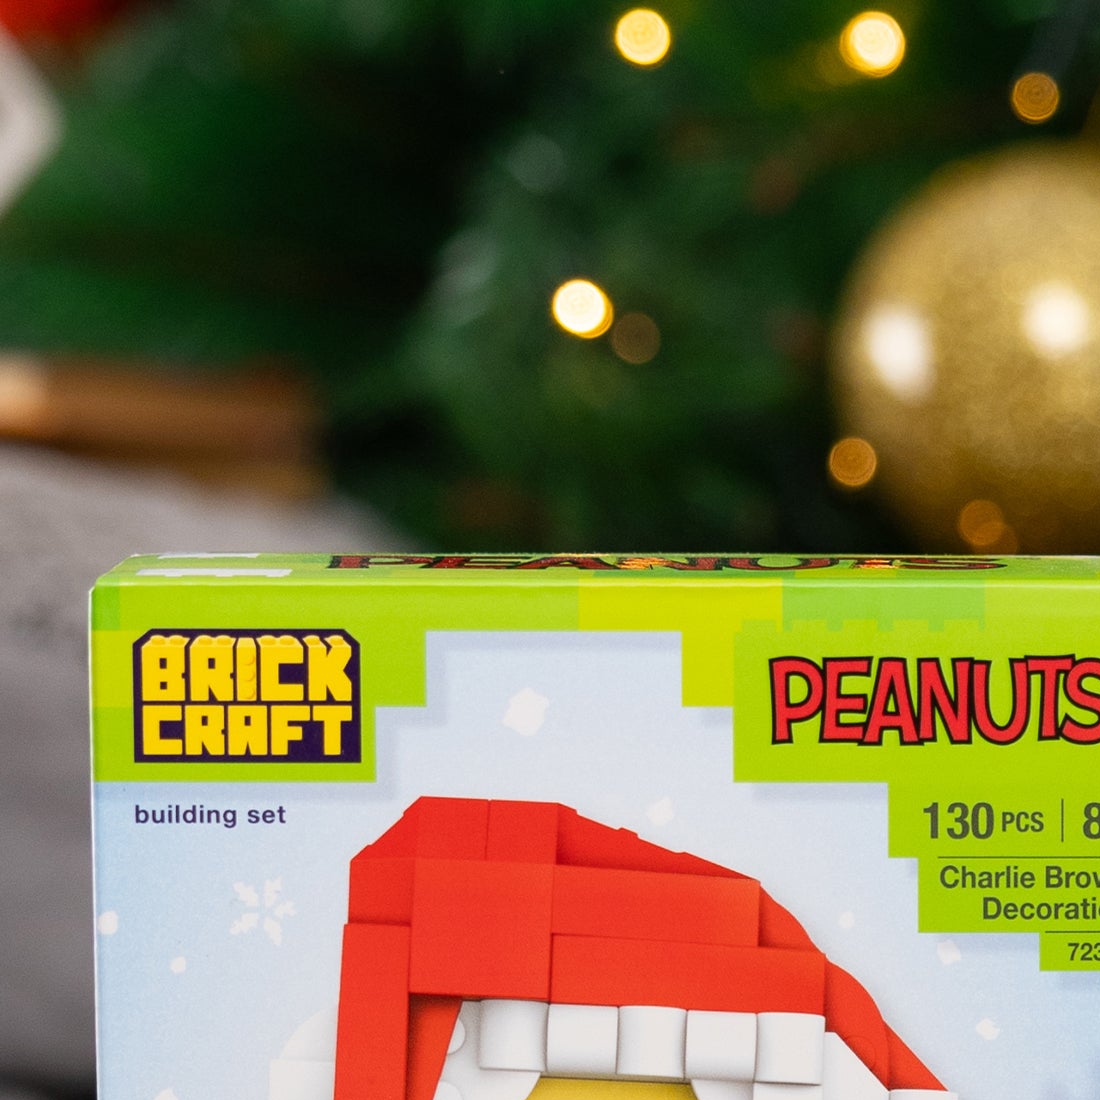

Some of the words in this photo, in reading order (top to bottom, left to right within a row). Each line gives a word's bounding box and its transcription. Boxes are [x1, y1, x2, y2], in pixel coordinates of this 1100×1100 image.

[326, 555, 1010, 571] PEANUTS
[141, 634, 353, 703] BRICK
[141, 705, 353, 757] CRAFT
[134, 804, 238, 829] building
[246, 806, 287, 826] set
[922, 801, 995, 841] 130
[1001, 811, 1045, 833] PCS
[939, 865, 1036, 890] Charlie
